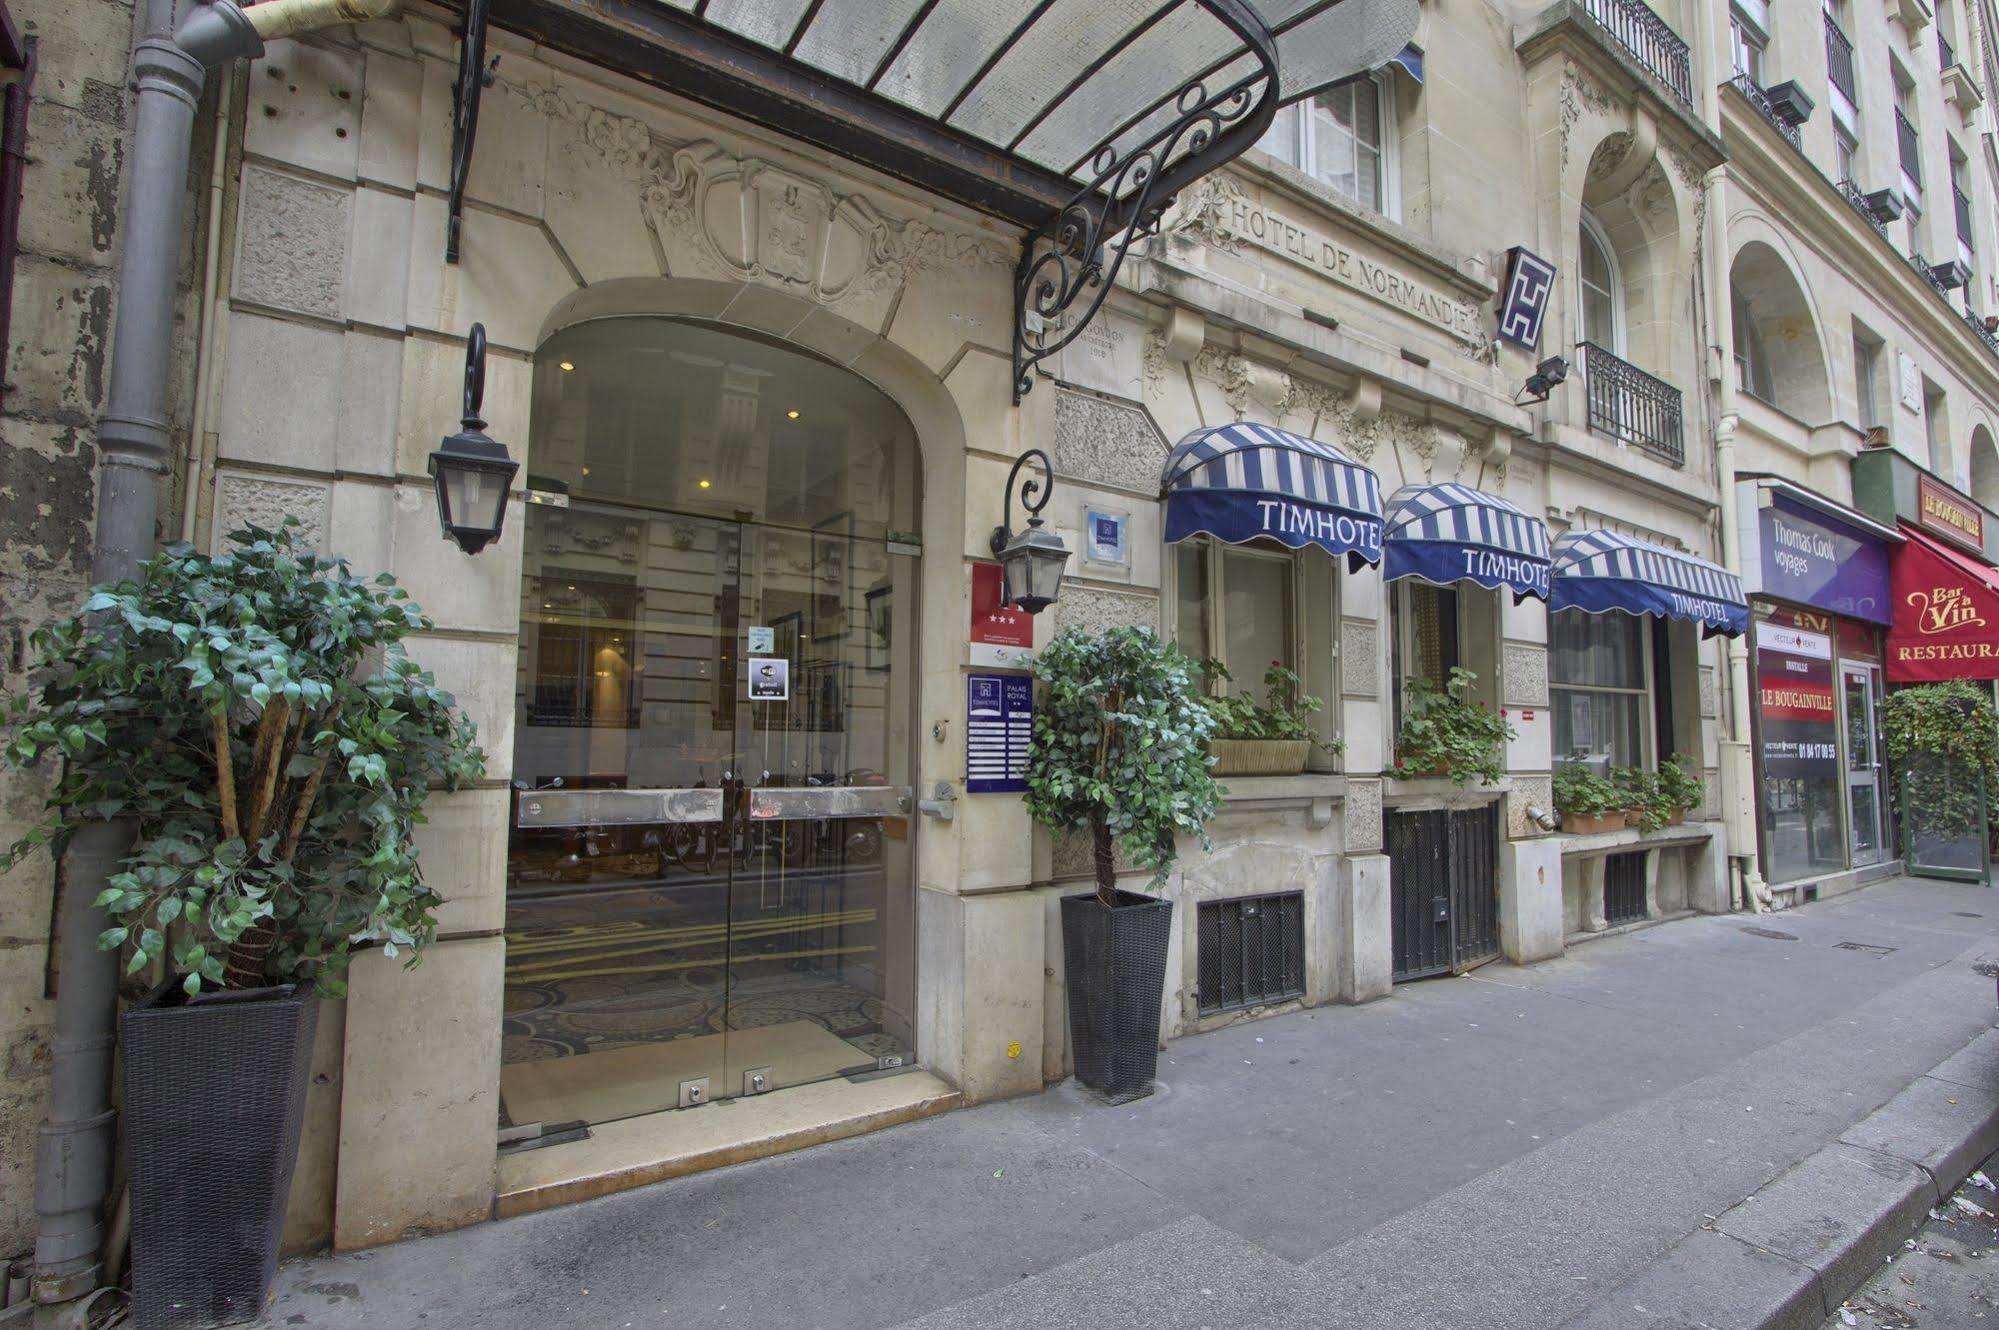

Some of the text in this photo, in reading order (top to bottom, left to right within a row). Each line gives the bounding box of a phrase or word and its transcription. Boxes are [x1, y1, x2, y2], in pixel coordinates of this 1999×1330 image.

[1230, 199, 1474, 334] HOTEL DE NORMANDIE
[1772, 518, 1835, 562] Thomas Cook
[1462, 549, 1549, 589] TIMHOTE
[1774, 549, 1808, 577] voyages
[1671, 593, 1729, 623] TIMHOTEL
[1932, 587, 1963, 604] Bar
[1928, 597, 1977, 630] Vin
[1007, 692, 1027, 700] ROYAL
[1762, 689, 1833, 711] LE BOUGAINVILLE
[1798, 743, 1806, 759] 01
[1814, 743, 1821, 759] 17
[1828, 743, 1836, 759] 55
